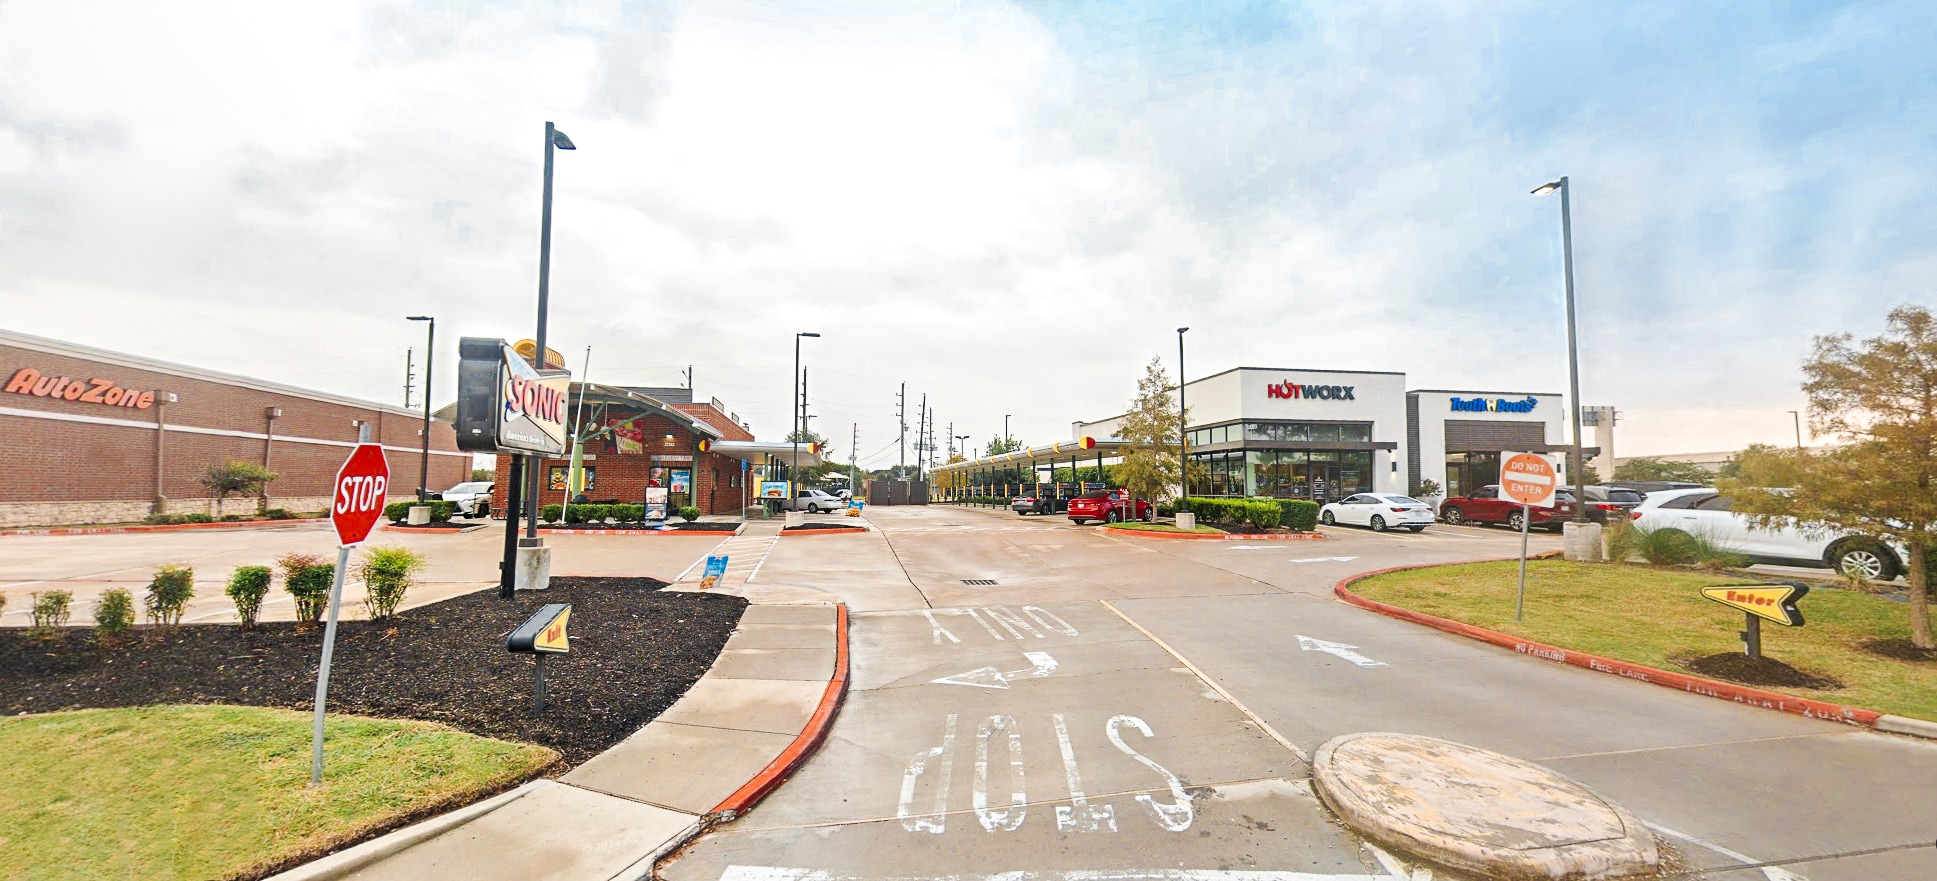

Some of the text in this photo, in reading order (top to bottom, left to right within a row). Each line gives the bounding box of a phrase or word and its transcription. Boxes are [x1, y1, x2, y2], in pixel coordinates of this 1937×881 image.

[4, 367, 155, 409] AutoZone
[1267, 379, 1355, 400] HOTWORX
[510, 374, 565, 425] SONIC
[1450, 397, 1534, 413] Tooth Boots
[1511, 461, 1545, 472] DO NOT
[336, 475, 386, 515] STOP
[1511, 483, 1541, 495] ENTER
[1726, 590, 1775, 606] Enter
[547, 624, 561, 644] Exit
[922, 605, 1079, 644] ONLY
[1515, 642, 1526, 654] NO
[1528, 644, 1565, 662] PARKING
[897, 714, 1193, 833] STOP
